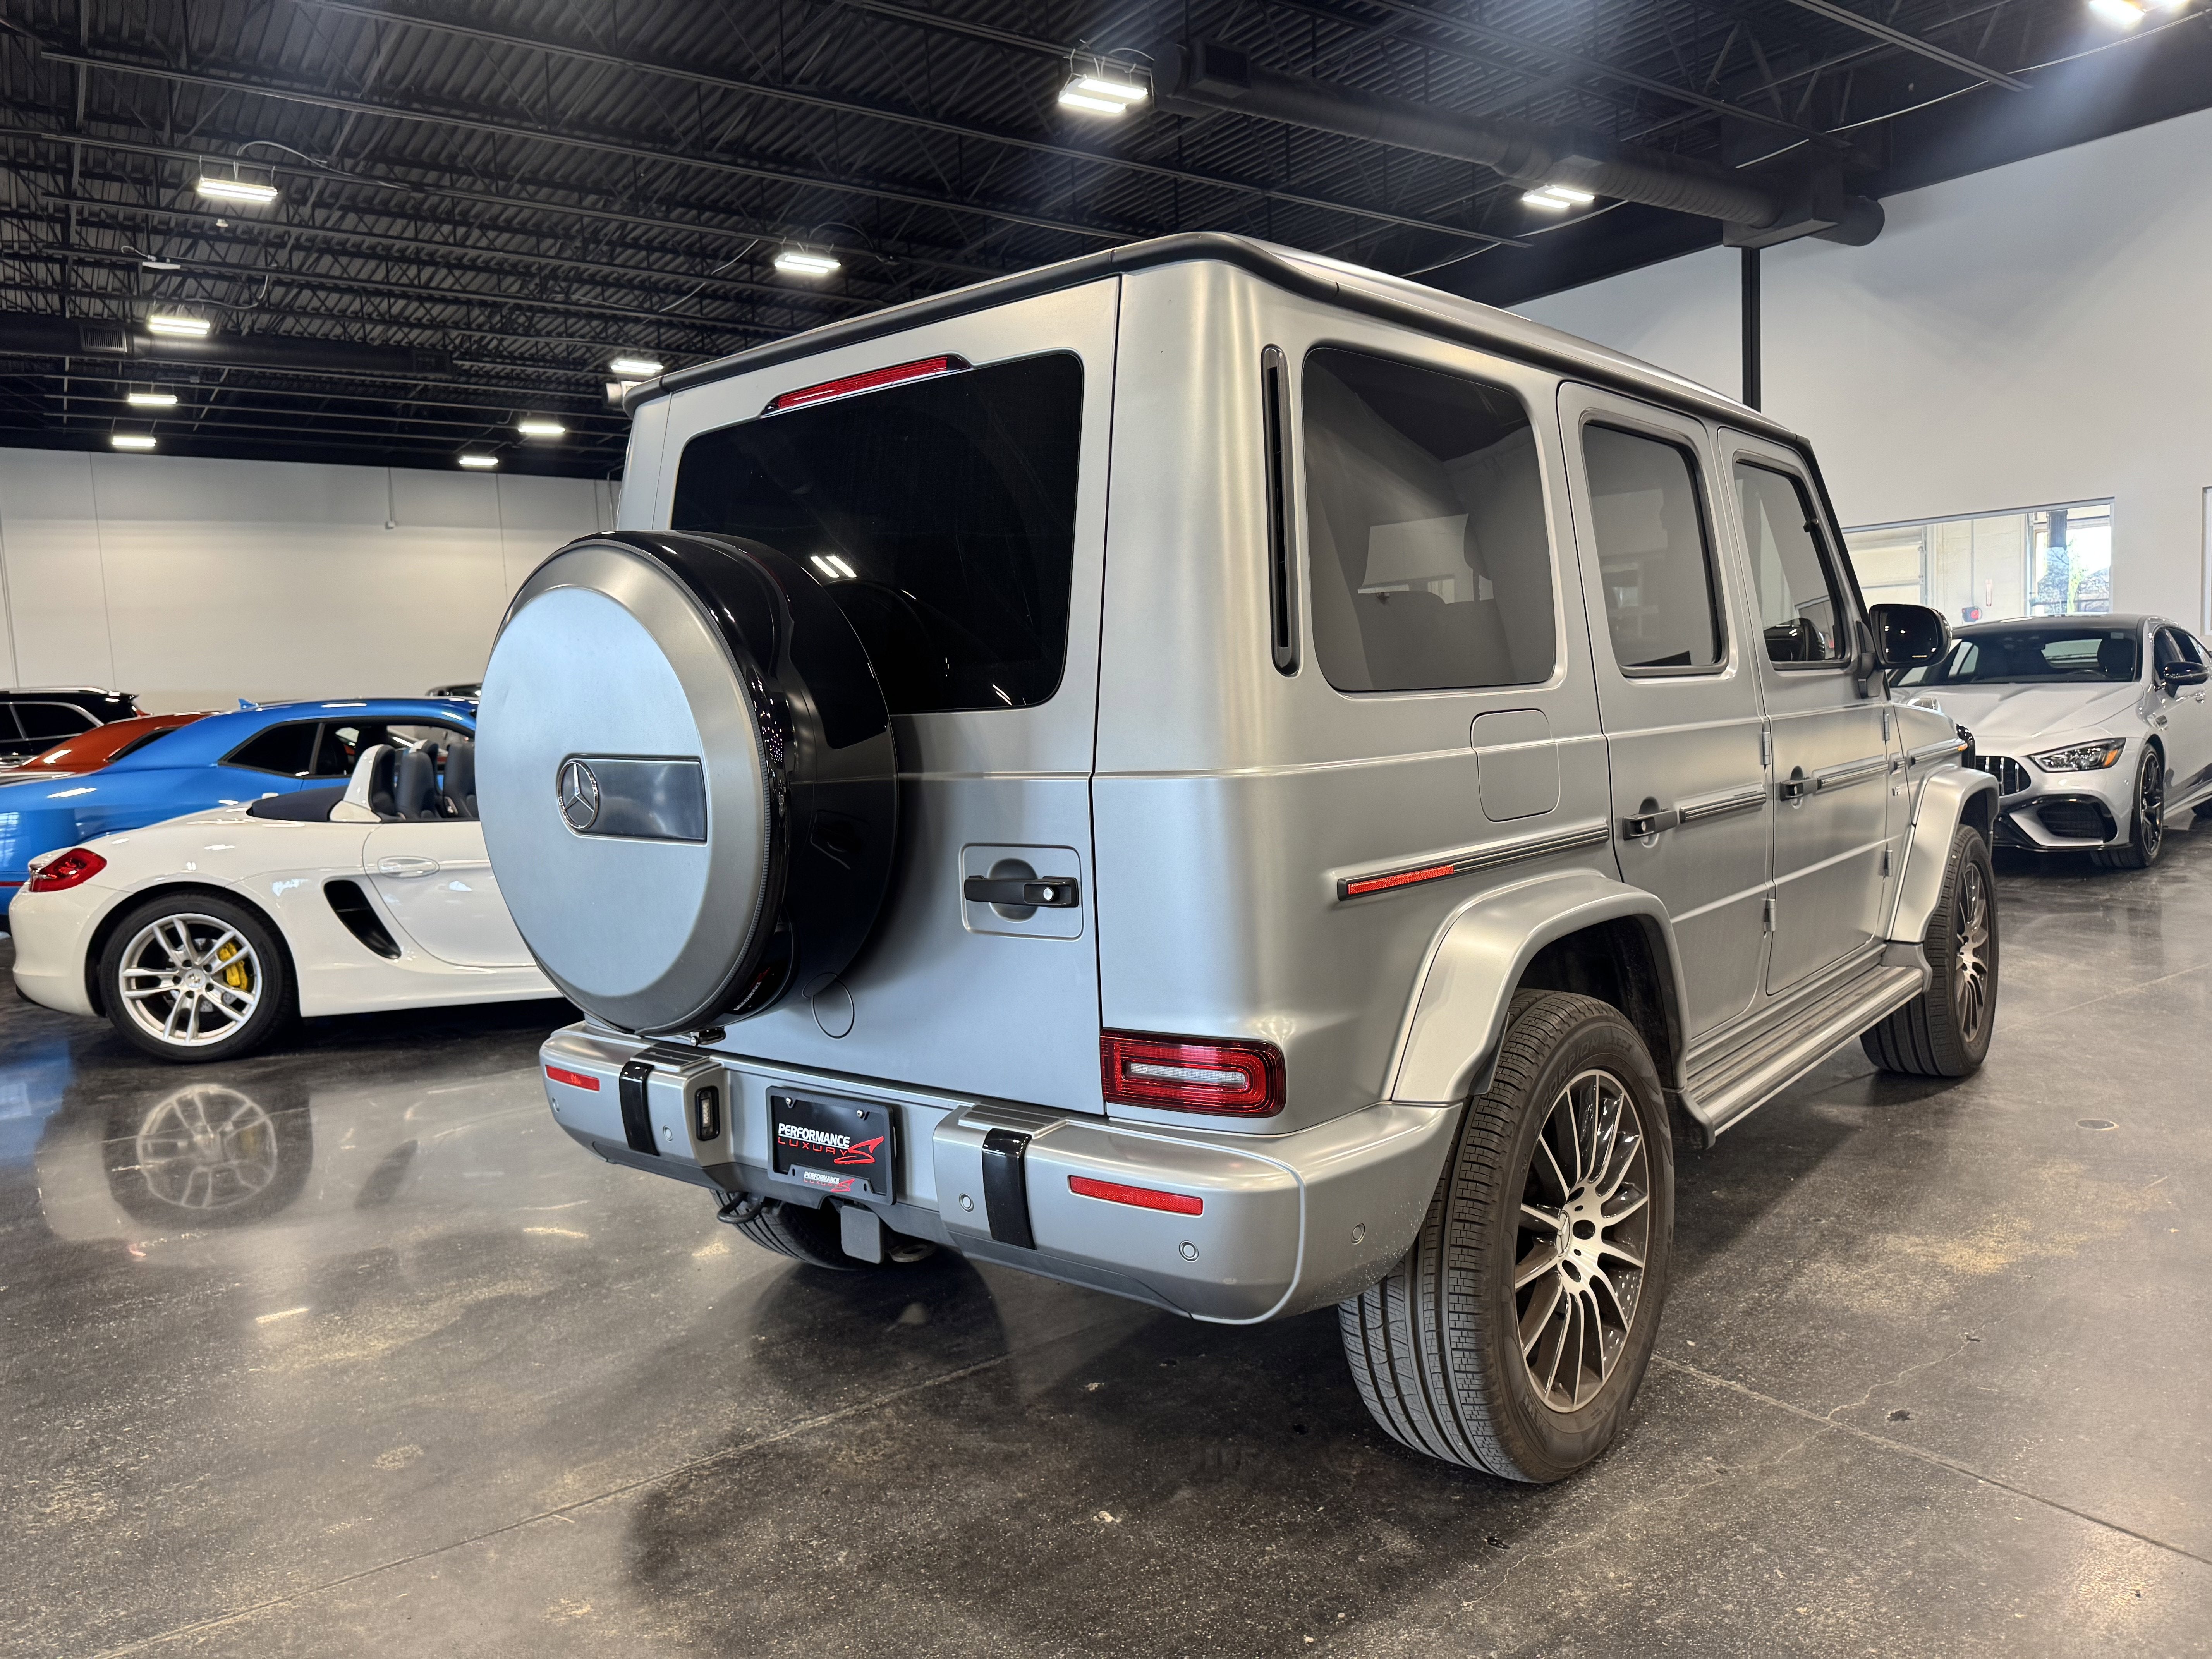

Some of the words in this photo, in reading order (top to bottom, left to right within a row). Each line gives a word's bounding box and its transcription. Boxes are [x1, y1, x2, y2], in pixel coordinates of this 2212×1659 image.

[778, 1123, 850, 1147] PERFORMANCE
[778, 1136, 848, 1156] LUXURY
[804, 1171, 840, 1185] PERFORMANCE
